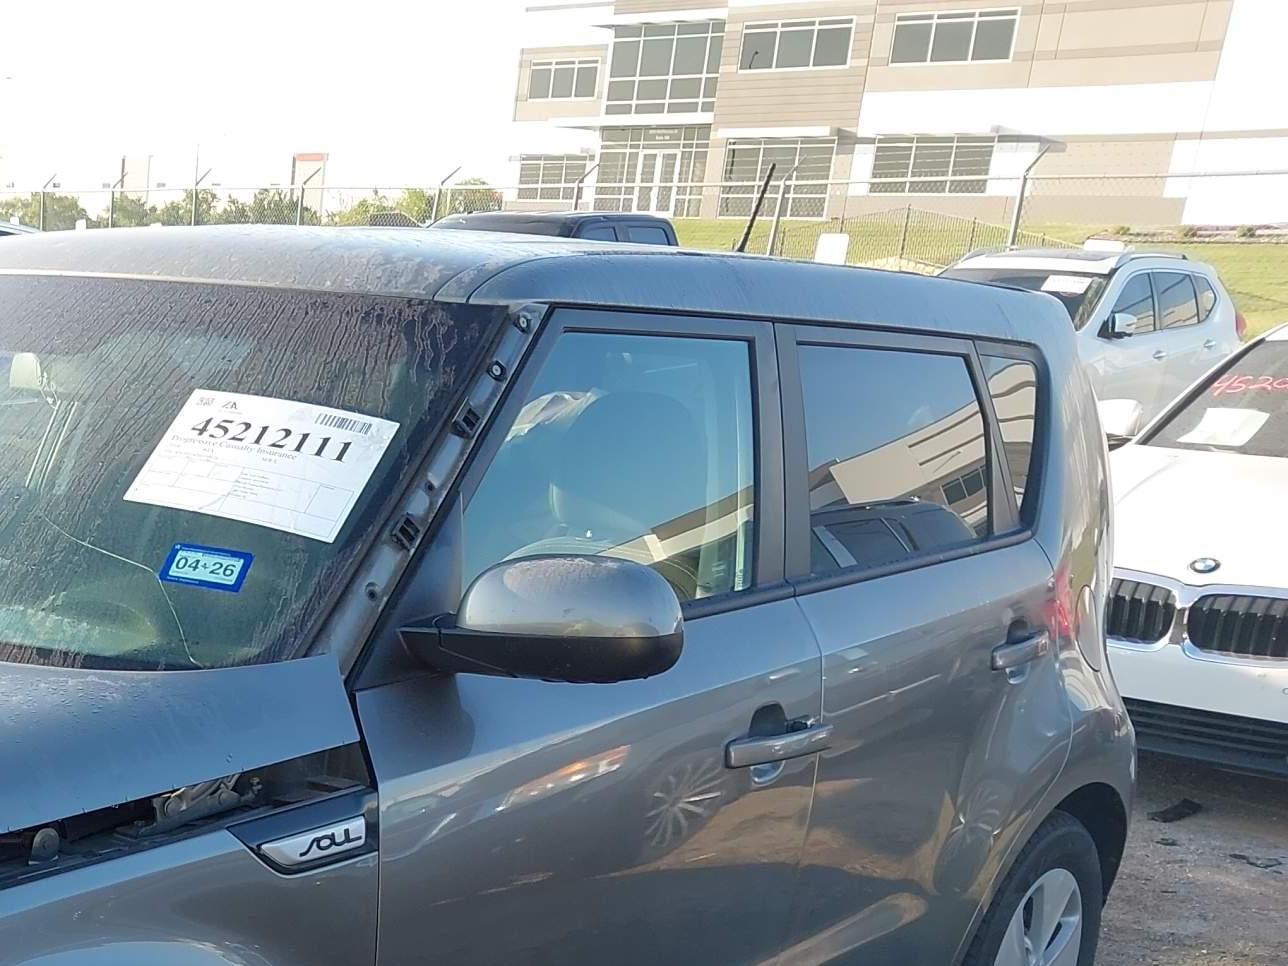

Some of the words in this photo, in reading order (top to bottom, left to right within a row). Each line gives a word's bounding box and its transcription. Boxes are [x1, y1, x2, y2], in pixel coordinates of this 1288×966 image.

[191, 416, 353, 463] 45212111
[219, 441, 255, 454] Casualty
[257, 447, 298, 461] Insurance
[299, 828, 362, 857] SOUL
